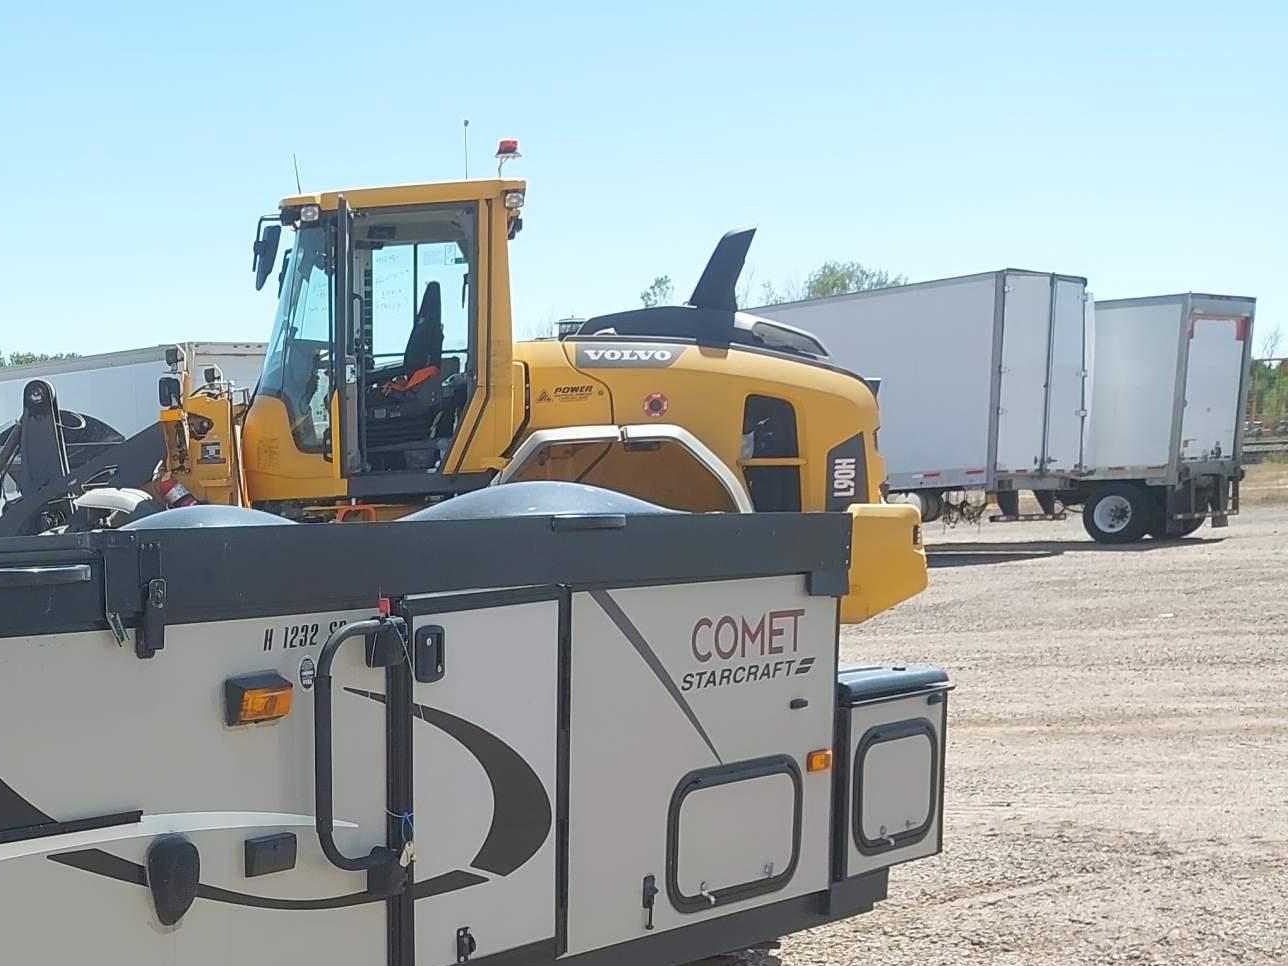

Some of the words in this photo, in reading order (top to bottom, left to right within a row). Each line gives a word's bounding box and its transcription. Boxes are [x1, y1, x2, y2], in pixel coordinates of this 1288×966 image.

[584, 350, 672, 361] VOLVO
[553, 385, 593, 394] POWER
[833, 458, 856, 497] L90H
[263, 628, 274, 652] H
[283, 623, 320, 649] 1232
[691, 608, 805, 663] COMET
[681, 660, 795, 691] STARCRAFT
